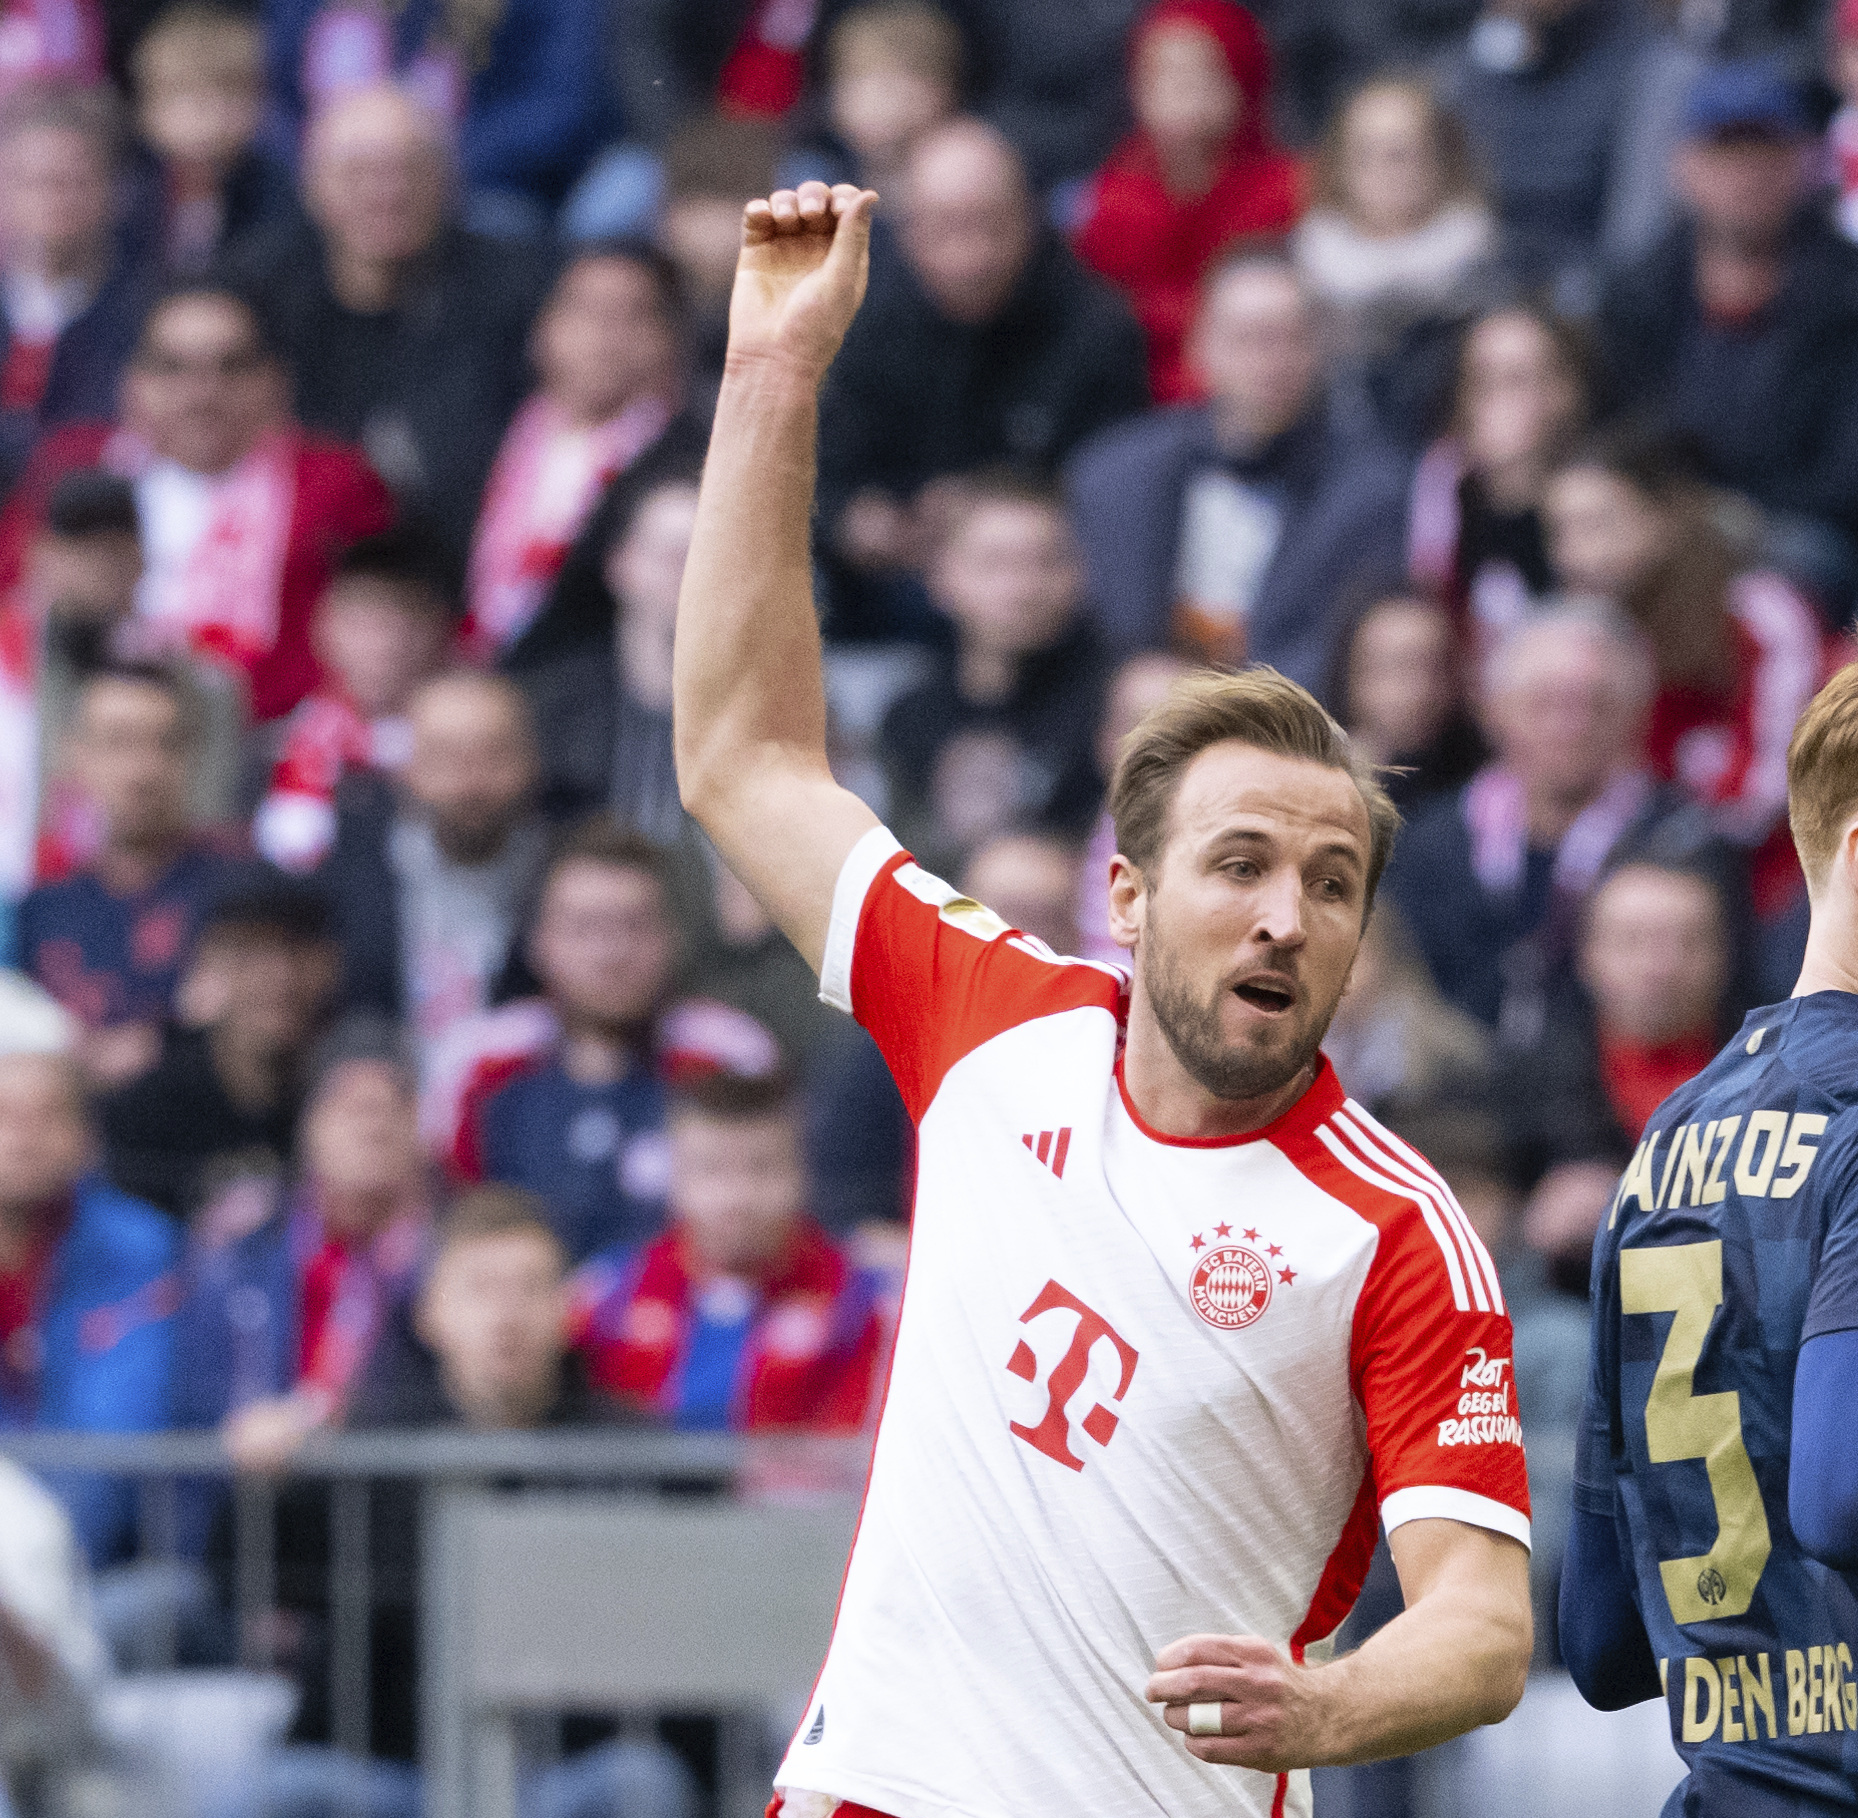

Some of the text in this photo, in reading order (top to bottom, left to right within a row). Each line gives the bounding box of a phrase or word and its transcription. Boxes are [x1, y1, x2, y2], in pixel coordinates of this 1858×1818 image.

[1733, 1110, 1829, 1199] 05
[1201, 1251, 1267, 1292] FC BAYERN
[1460, 1346, 1510, 1389] ROT
[1458, 1381, 1508, 1416] GEGEN
[1438, 1415, 1526, 1448] RASSISM
[1620, 1239, 1772, 1625] 3
[1682, 1652, 1778, 1744] DEN
[1785, 1642, 1858, 1736] BERG
